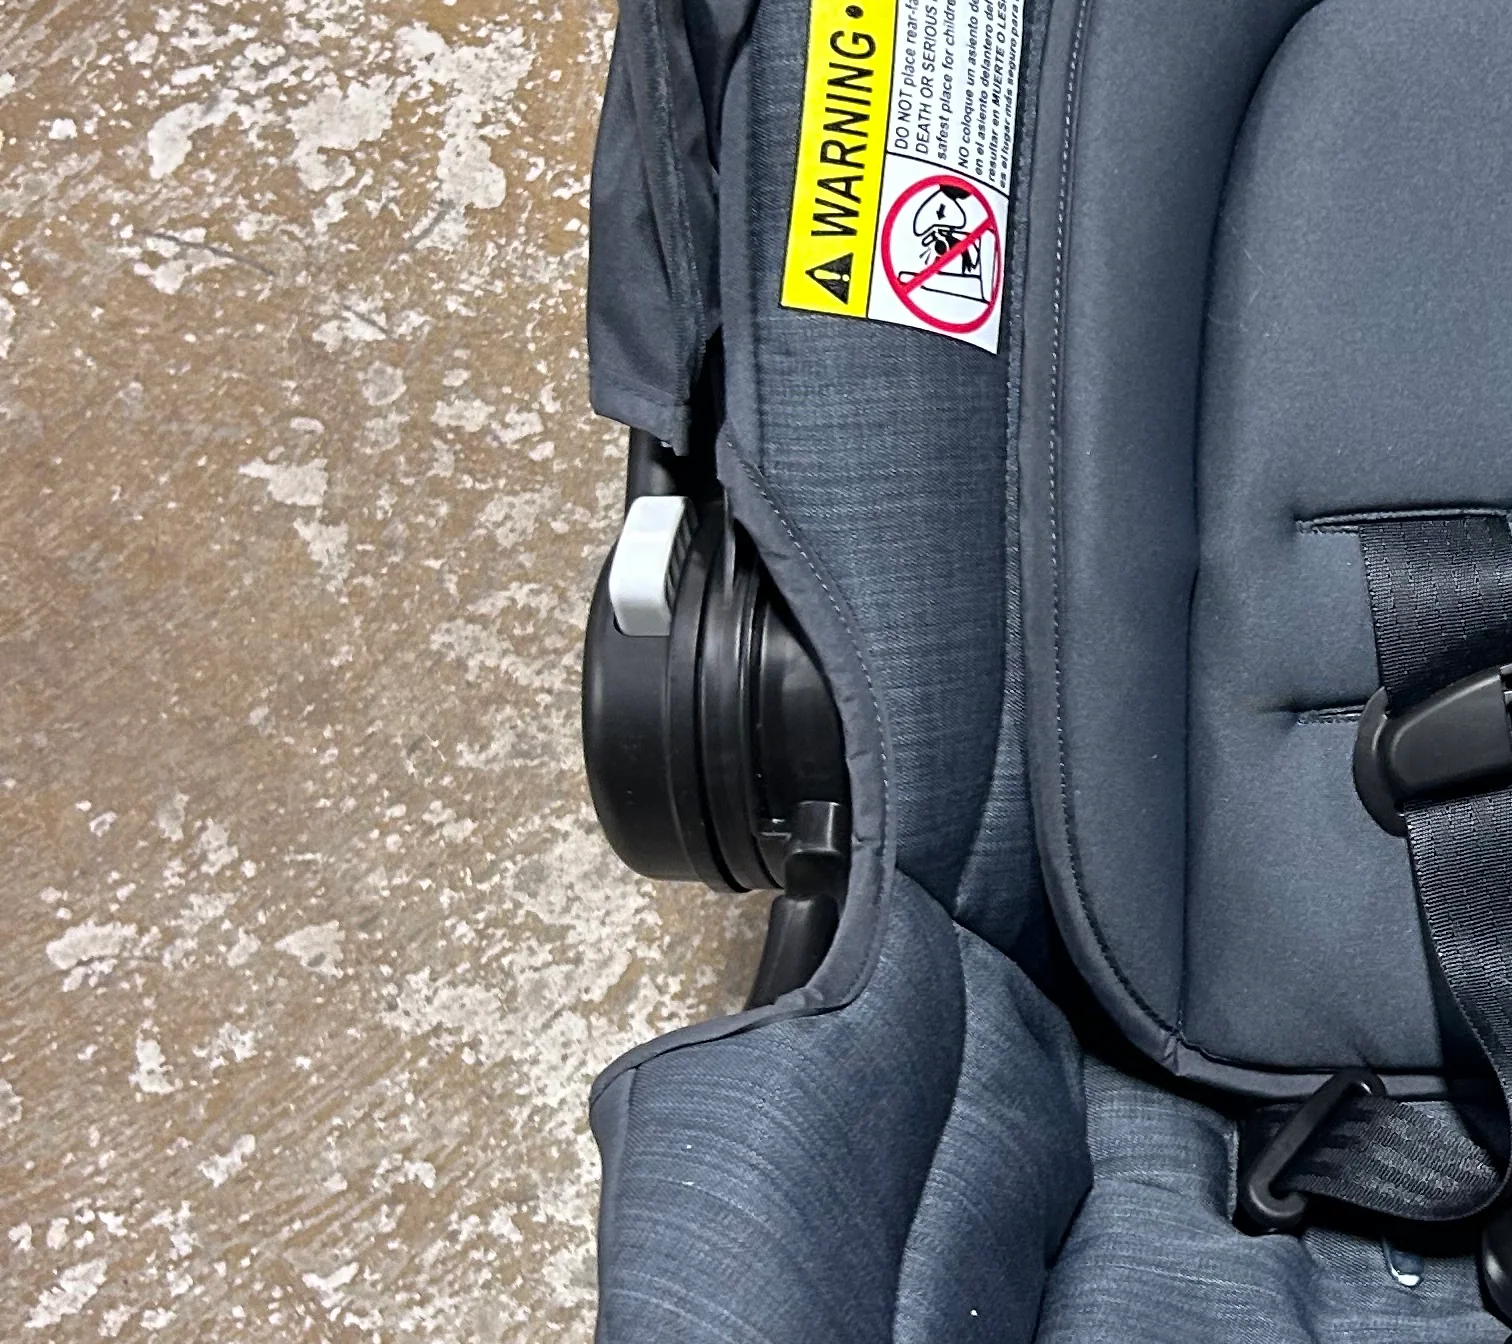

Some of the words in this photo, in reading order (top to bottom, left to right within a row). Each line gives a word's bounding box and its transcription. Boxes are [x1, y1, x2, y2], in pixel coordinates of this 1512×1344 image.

[920, 4, 938, 73] SERIOUS
[995, 30, 1006, 44] O
[1009, 3, 1022, 37] para
[940, 46, 955, 70] for
[964, 14, 979, 65] asiento
[978, 23, 993, 87] delantero
[899, 46, 920, 88] place
[965, 67, 975, 86] un
[990, 44, 1005, 107] MUERTE
[1006, 36, 1019, 86] seguro
[896, 88, 913, 123] NOT
[919, 74, 935, 100] OR
[937, 72, 956, 114] place
[1002, 86, 1014, 117] más
[914, 101, 933, 154] DEATH
[958, 87, 977, 144] coloque
[974, 88, 989, 140] asiento
[991, 108, 1001, 127] en
[809, 24, 877, 247] WARNING
[893, 124, 910, 150] DO
[933, 114, 950, 160] safest
[974, 141, 985, 156] el
[1000, 116, 1013, 155] lugar
[956, 145, 970, 169] NO
[974, 157, 983, 176] en
[985, 127, 1000, 182] resultar
[999, 154, 1008, 169] el
[998, 171, 1006, 188] es
